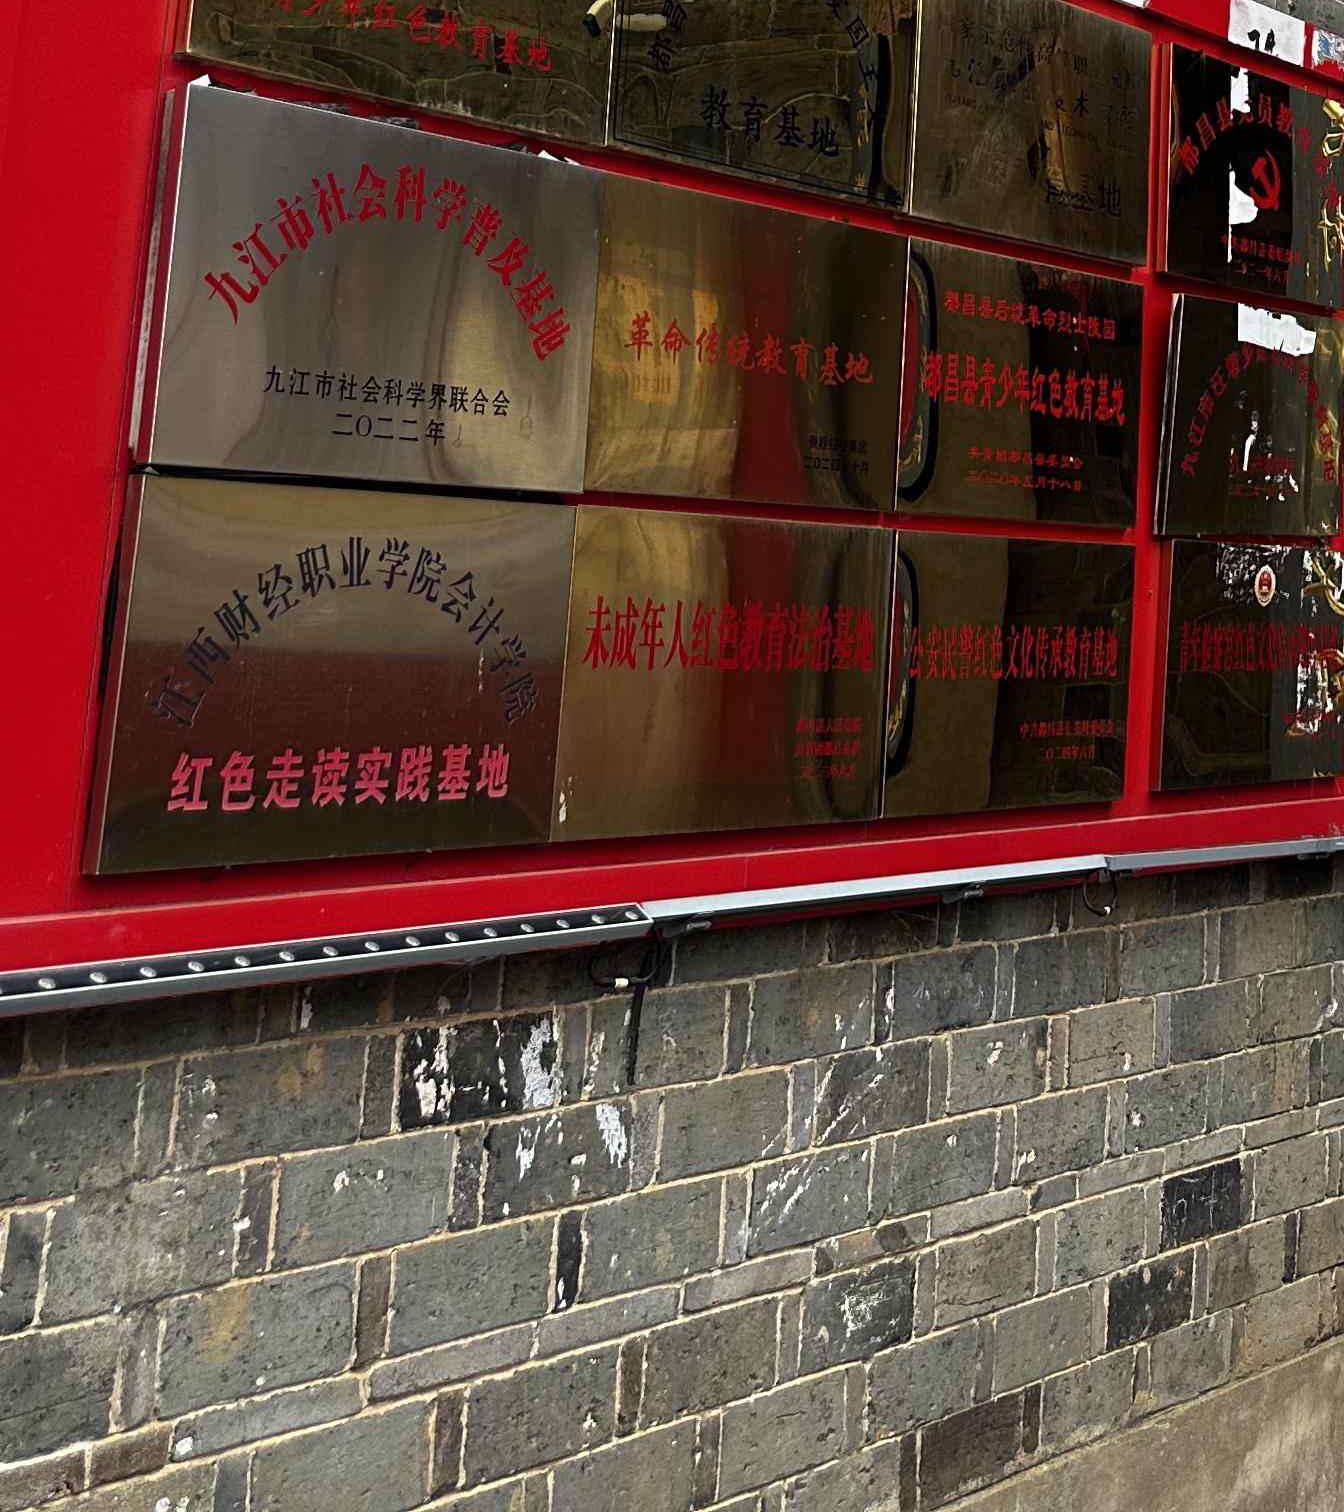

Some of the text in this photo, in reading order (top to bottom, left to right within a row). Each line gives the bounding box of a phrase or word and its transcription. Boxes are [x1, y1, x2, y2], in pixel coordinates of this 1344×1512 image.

[700, 84, 839, 156] 教育基地
[202, 162, 571, 362] 九江市社会科学普及基地
[624, 311, 874, 386] 革命传统教育基地
[263, 365, 512, 417] 九江市社会科学界联合会
[924, 352, 1126, 427] 都昌县青少年红色教育基地
[149, 536, 540, 730] 江西财经职业学院会计学院
[167, 743, 510, 813] 红色走读实践基地
